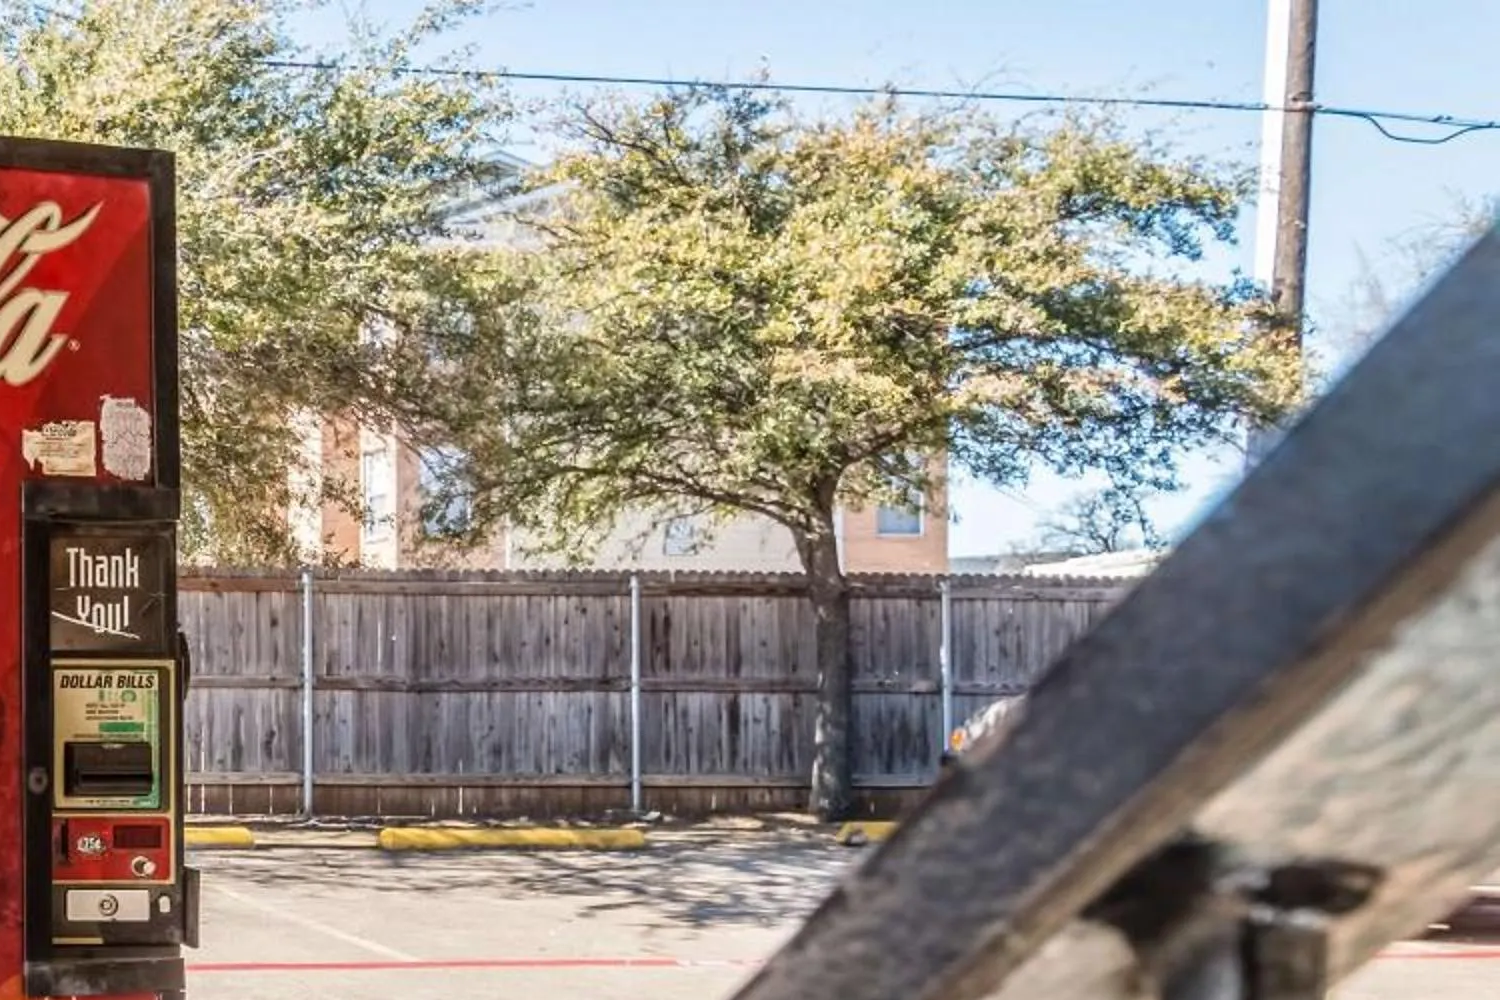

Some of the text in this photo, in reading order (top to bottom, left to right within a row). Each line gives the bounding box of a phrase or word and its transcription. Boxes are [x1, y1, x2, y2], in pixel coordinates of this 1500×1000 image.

[65, 547, 139, 588] Thank
[77, 595, 129, 633] You!
[60, 674, 155, 689] DOLLAR BILLS
